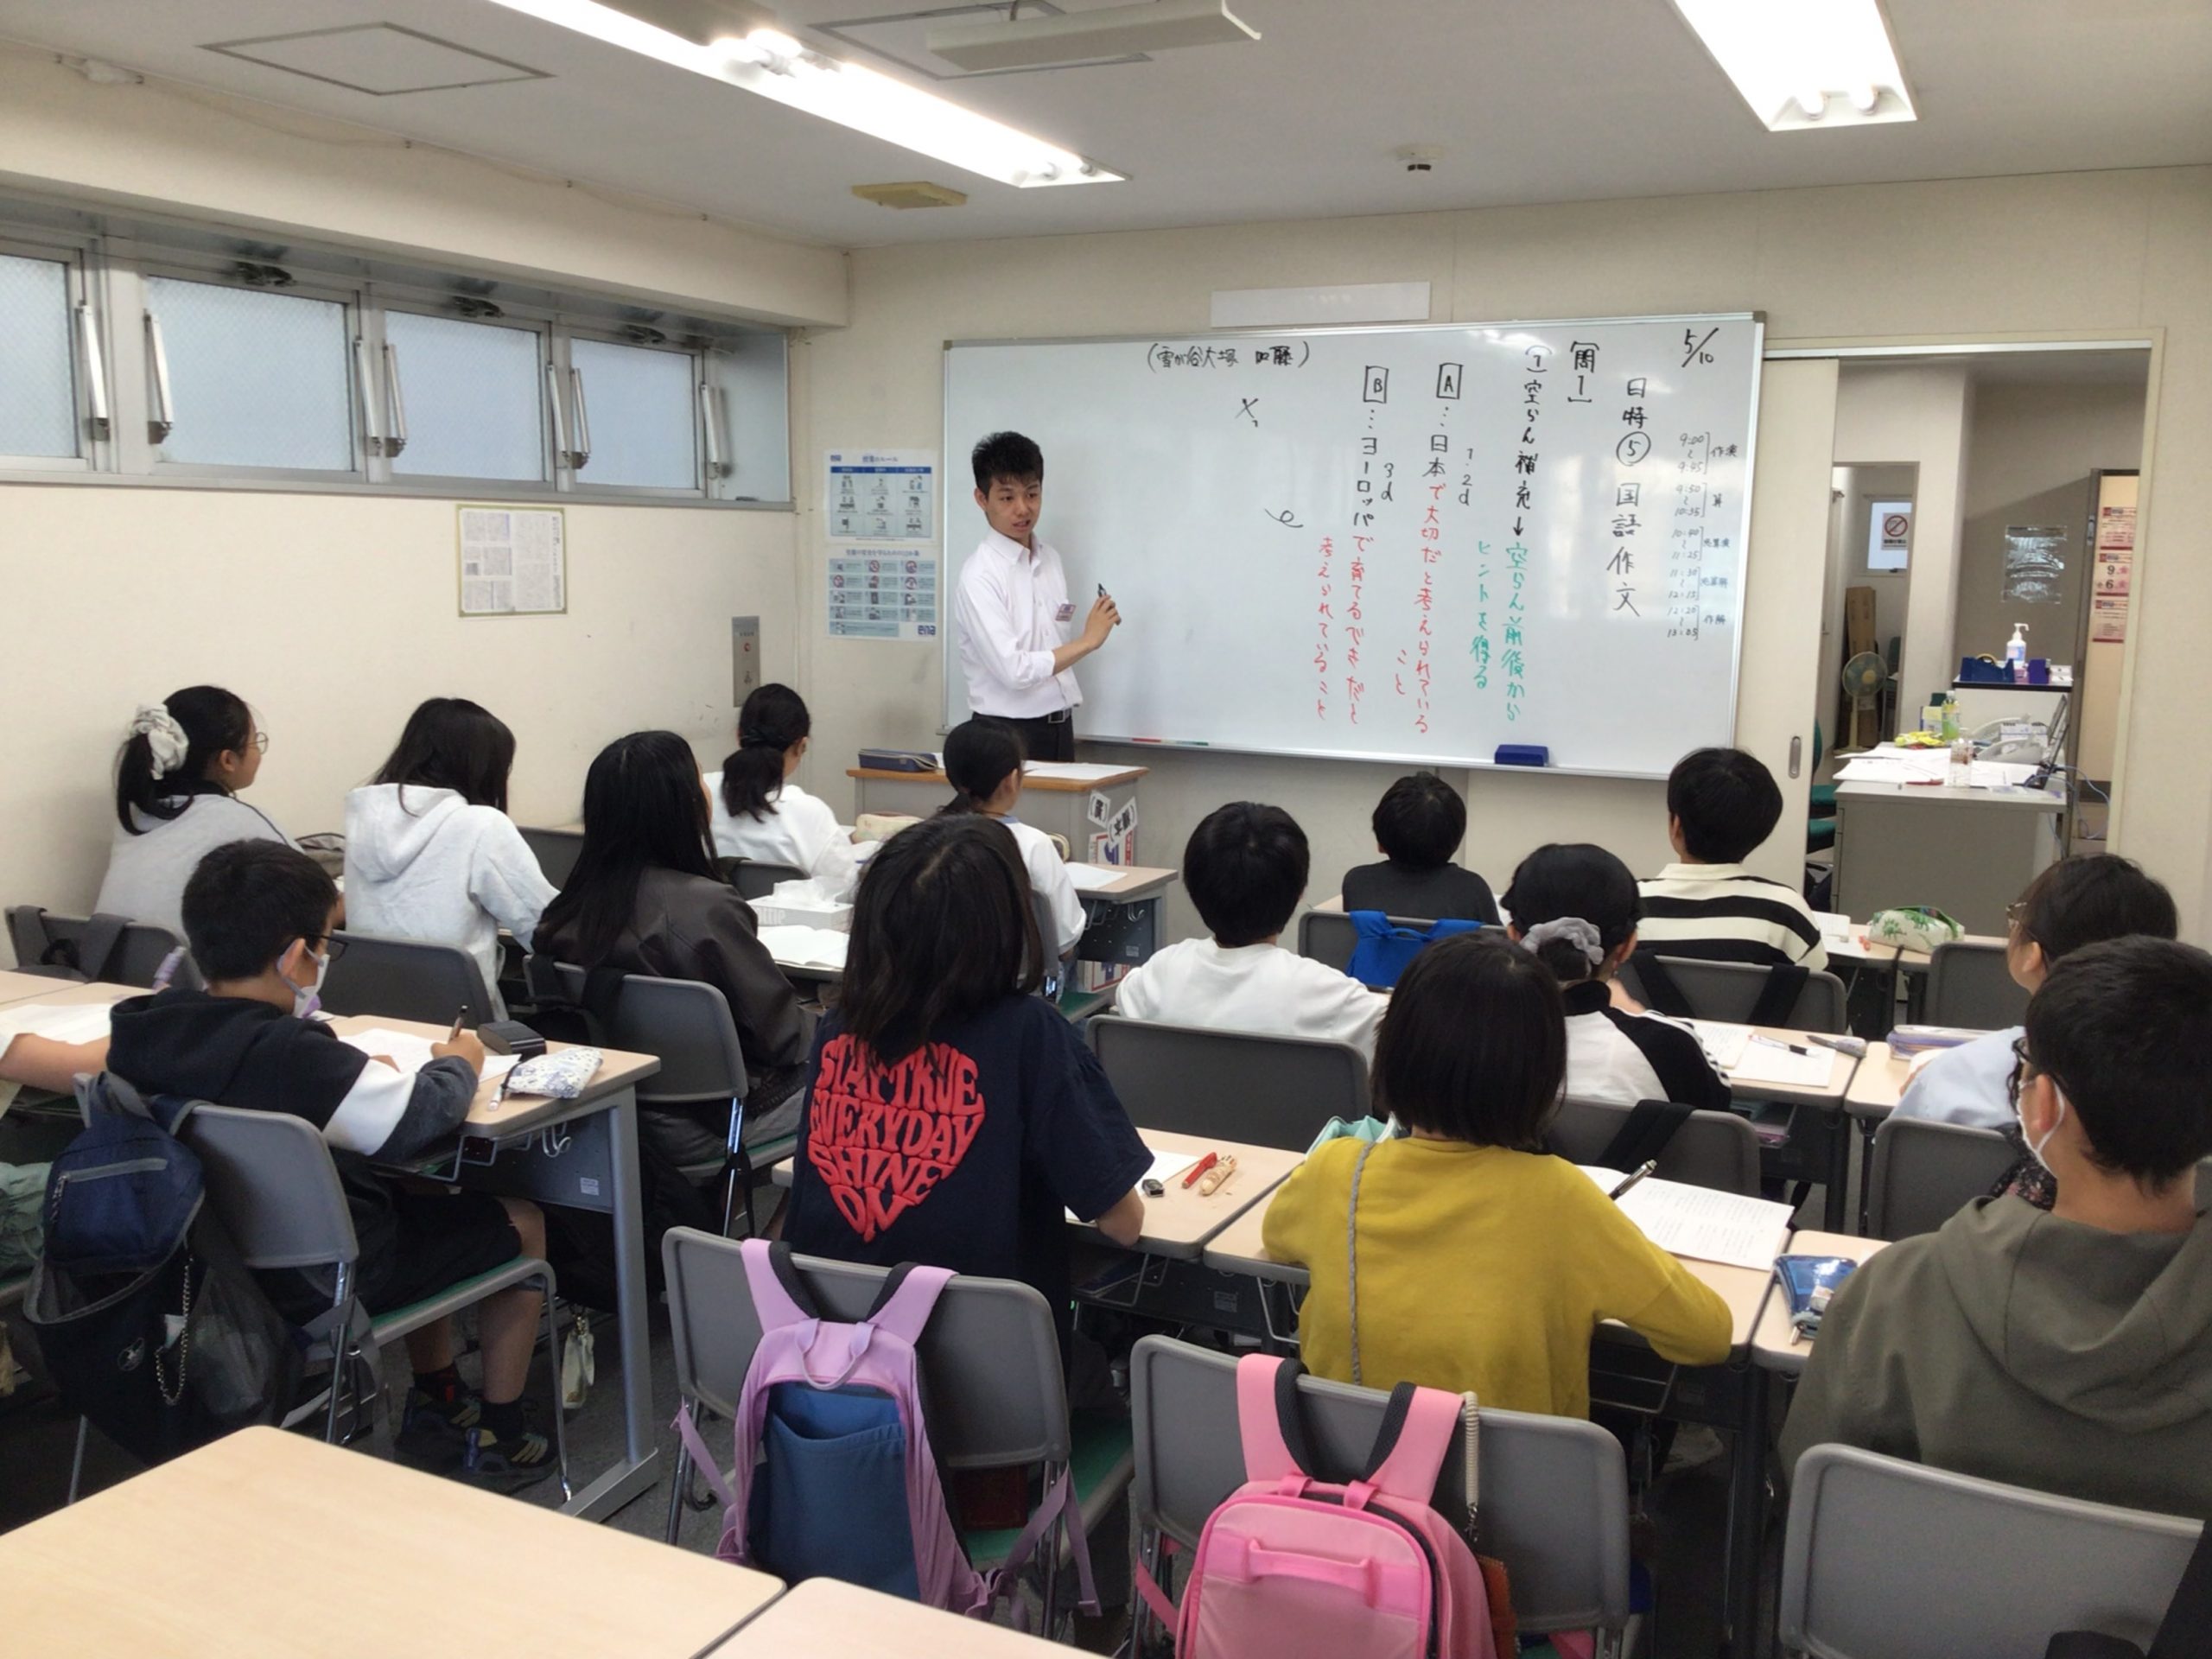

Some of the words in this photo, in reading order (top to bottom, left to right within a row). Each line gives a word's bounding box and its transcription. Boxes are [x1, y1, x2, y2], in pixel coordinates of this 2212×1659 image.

[1681, 327, 1719, 368] 5/10
[888, 1042, 985, 1115] TRUE
[809, 1089, 986, 1165] EVERYDAY
[808, 1140, 957, 1206] SHINE
[830, 1184, 917, 1243] ON
